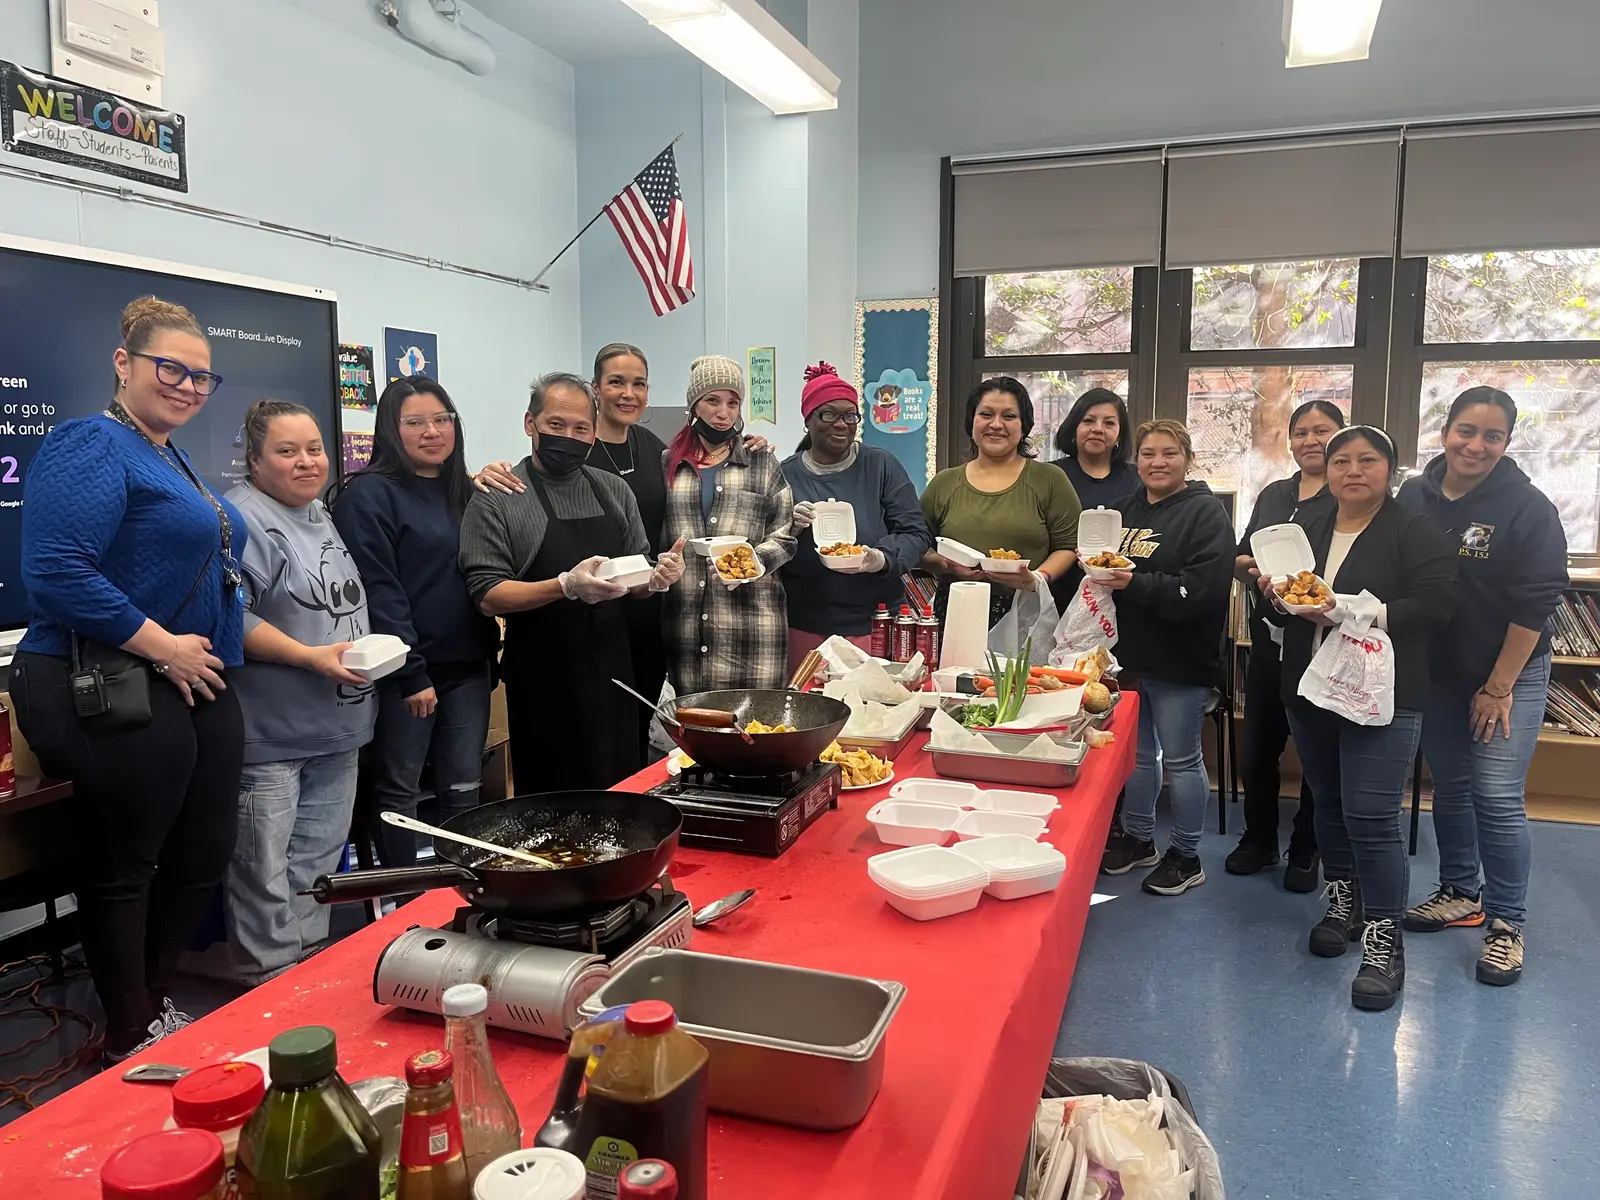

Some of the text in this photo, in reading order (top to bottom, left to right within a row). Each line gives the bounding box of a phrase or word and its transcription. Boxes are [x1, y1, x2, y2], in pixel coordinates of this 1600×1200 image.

[17, 84, 174, 154] WELCOME
[207, 326, 237, 339] SMART
[276, 335, 302, 347] Display
[903, 387, 923, 395] Books
[4, 402, 56, 418] or go to
[902, 412, 924, 420] treat!
[18, 421, 45, 435] and
[0, 455, 20, 484] 2
[0, 500, 20, 508] Google
[1474, 550, 1489, 559] 152
[1097, 613, 1116, 639] YOU
